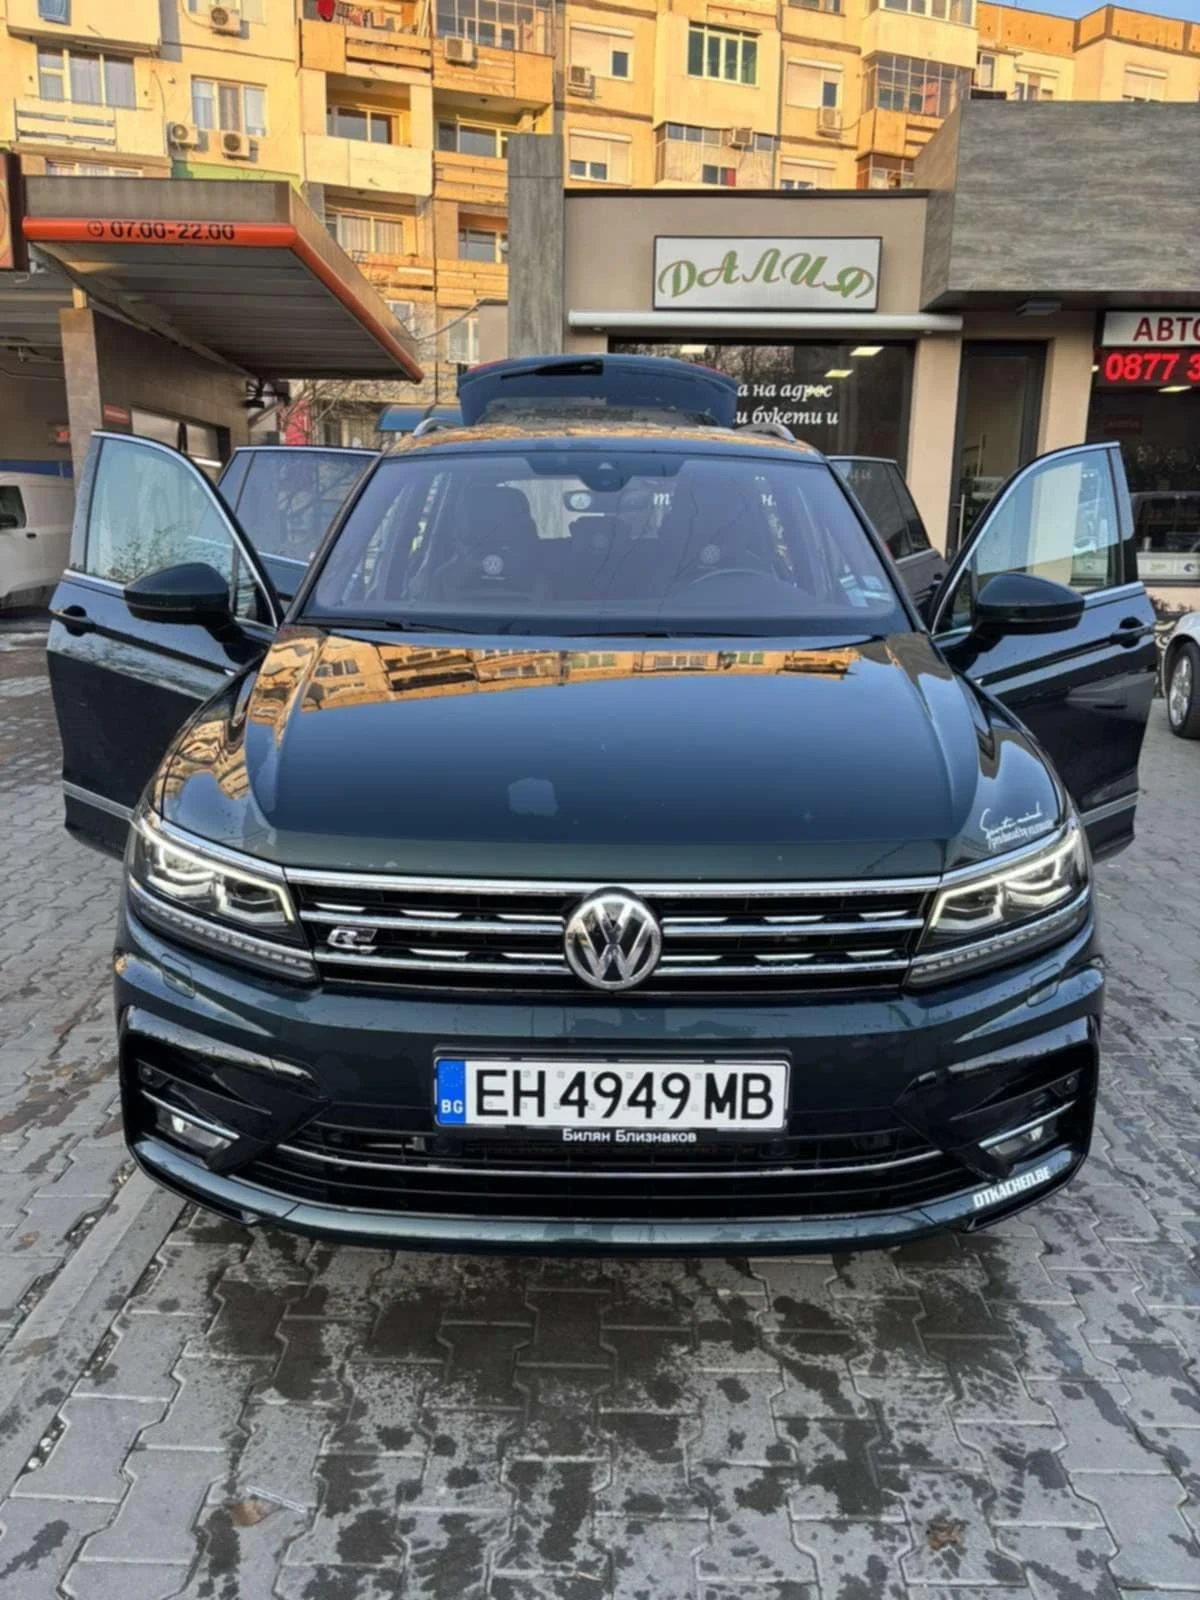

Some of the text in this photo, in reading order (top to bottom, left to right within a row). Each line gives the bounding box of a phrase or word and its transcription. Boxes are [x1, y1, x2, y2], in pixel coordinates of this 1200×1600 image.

[110, 220, 235, 240] 07.00-22.00
[658, 248, 875, 299] ДАЛИЯ
[1104, 352, 1180, 382] 0877
[753, 383, 777, 397] на
[780, 383, 833, 402] адрес
[752, 405, 822, 425] букети
[826, 411, 840, 425] и
[476, 1069, 774, 1120] EH 4949 MB
[441, 1099, 464, 1114] BG
[562, 1128, 697, 1143] Билян Близнаков
